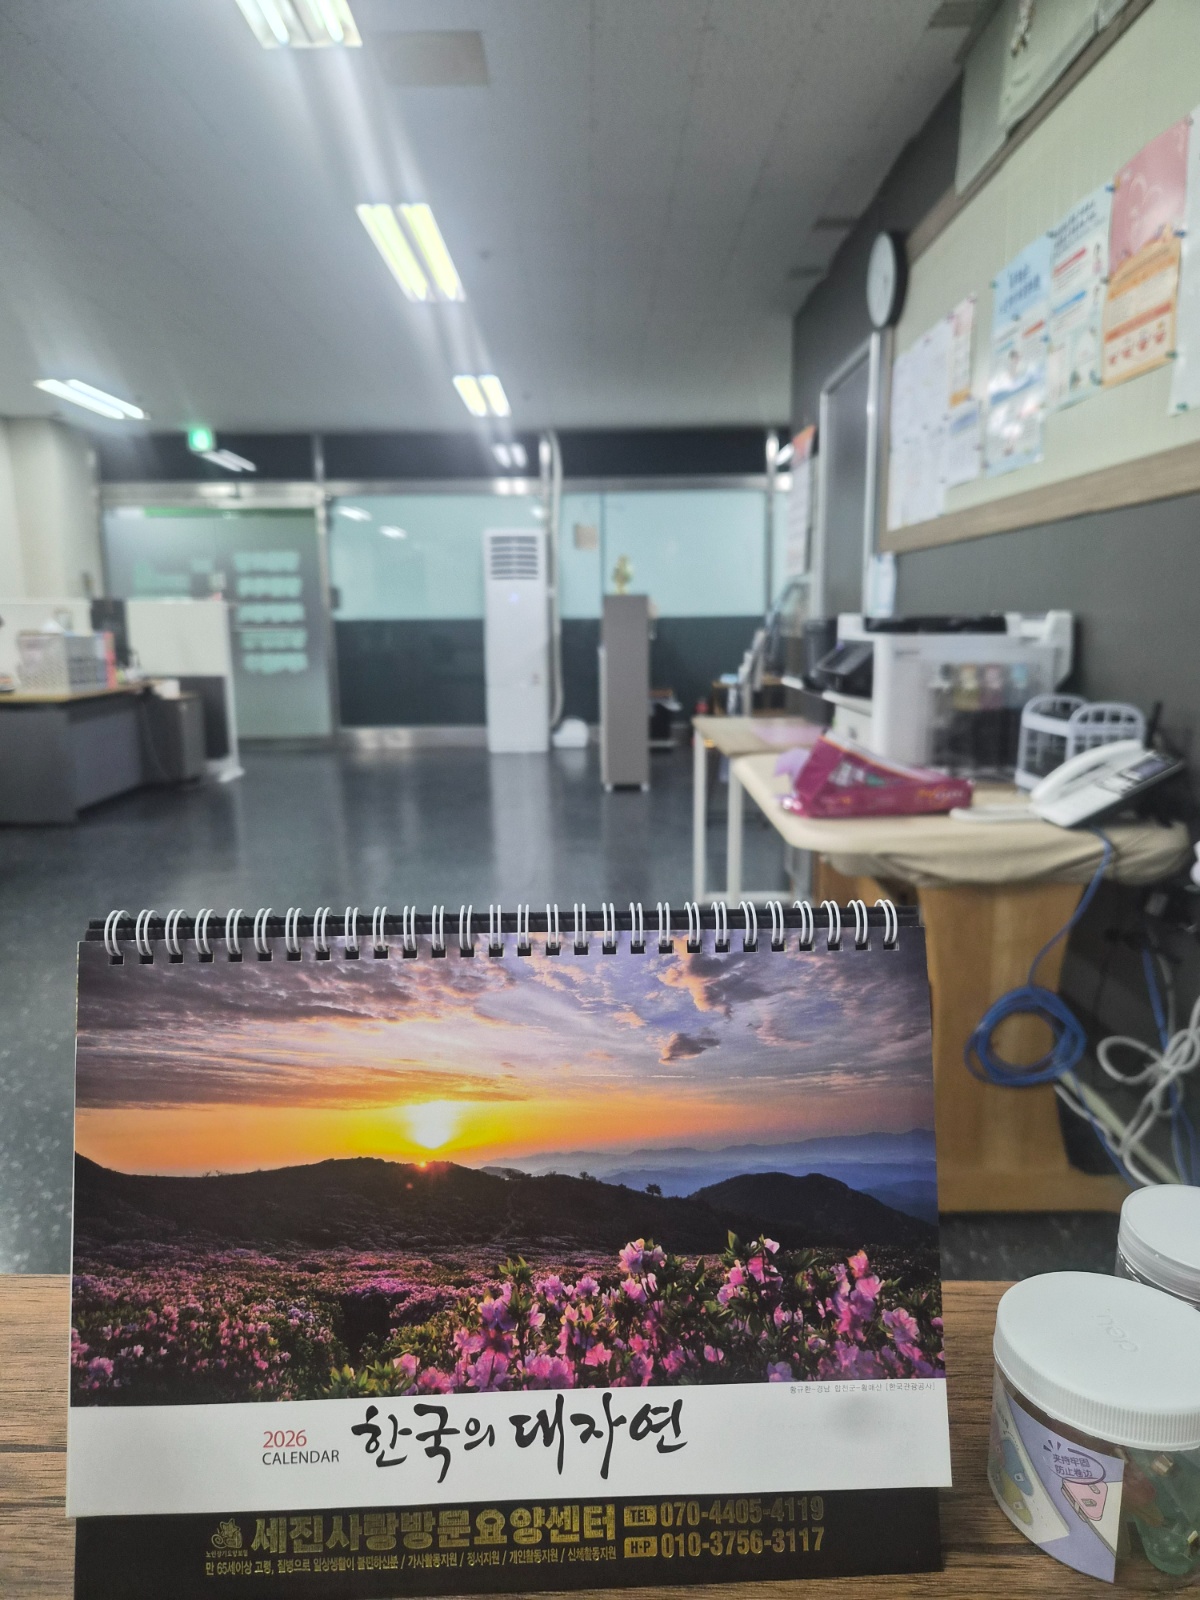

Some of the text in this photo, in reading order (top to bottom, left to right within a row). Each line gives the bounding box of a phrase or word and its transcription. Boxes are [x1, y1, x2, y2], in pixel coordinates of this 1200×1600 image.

[262, 1429, 307, 1449] 2026
[351, 1392, 688, 1483] 한국의 대자연
[262, 1449, 340, 1466] CALENDAR
[1053, 1453, 1091, 1468] 夹持牢固
[1054, 1464, 1093, 1478] 防止卷边
[630, 1495, 824, 1527] TEL 070-4405-4119
[250, 1503, 616, 1554] 세진사랑방문요양센터
[660, 1526, 825, 1558] 010-3756-3117
[205, 1561, 214, 1575] 만
[217, 1560, 252, 1575] 65세이상
[277, 1558, 311, 1573] 질병으로
[313, 1556, 354, 1572] 일상생활이
[467, 1550, 500, 1566] 정서지원
